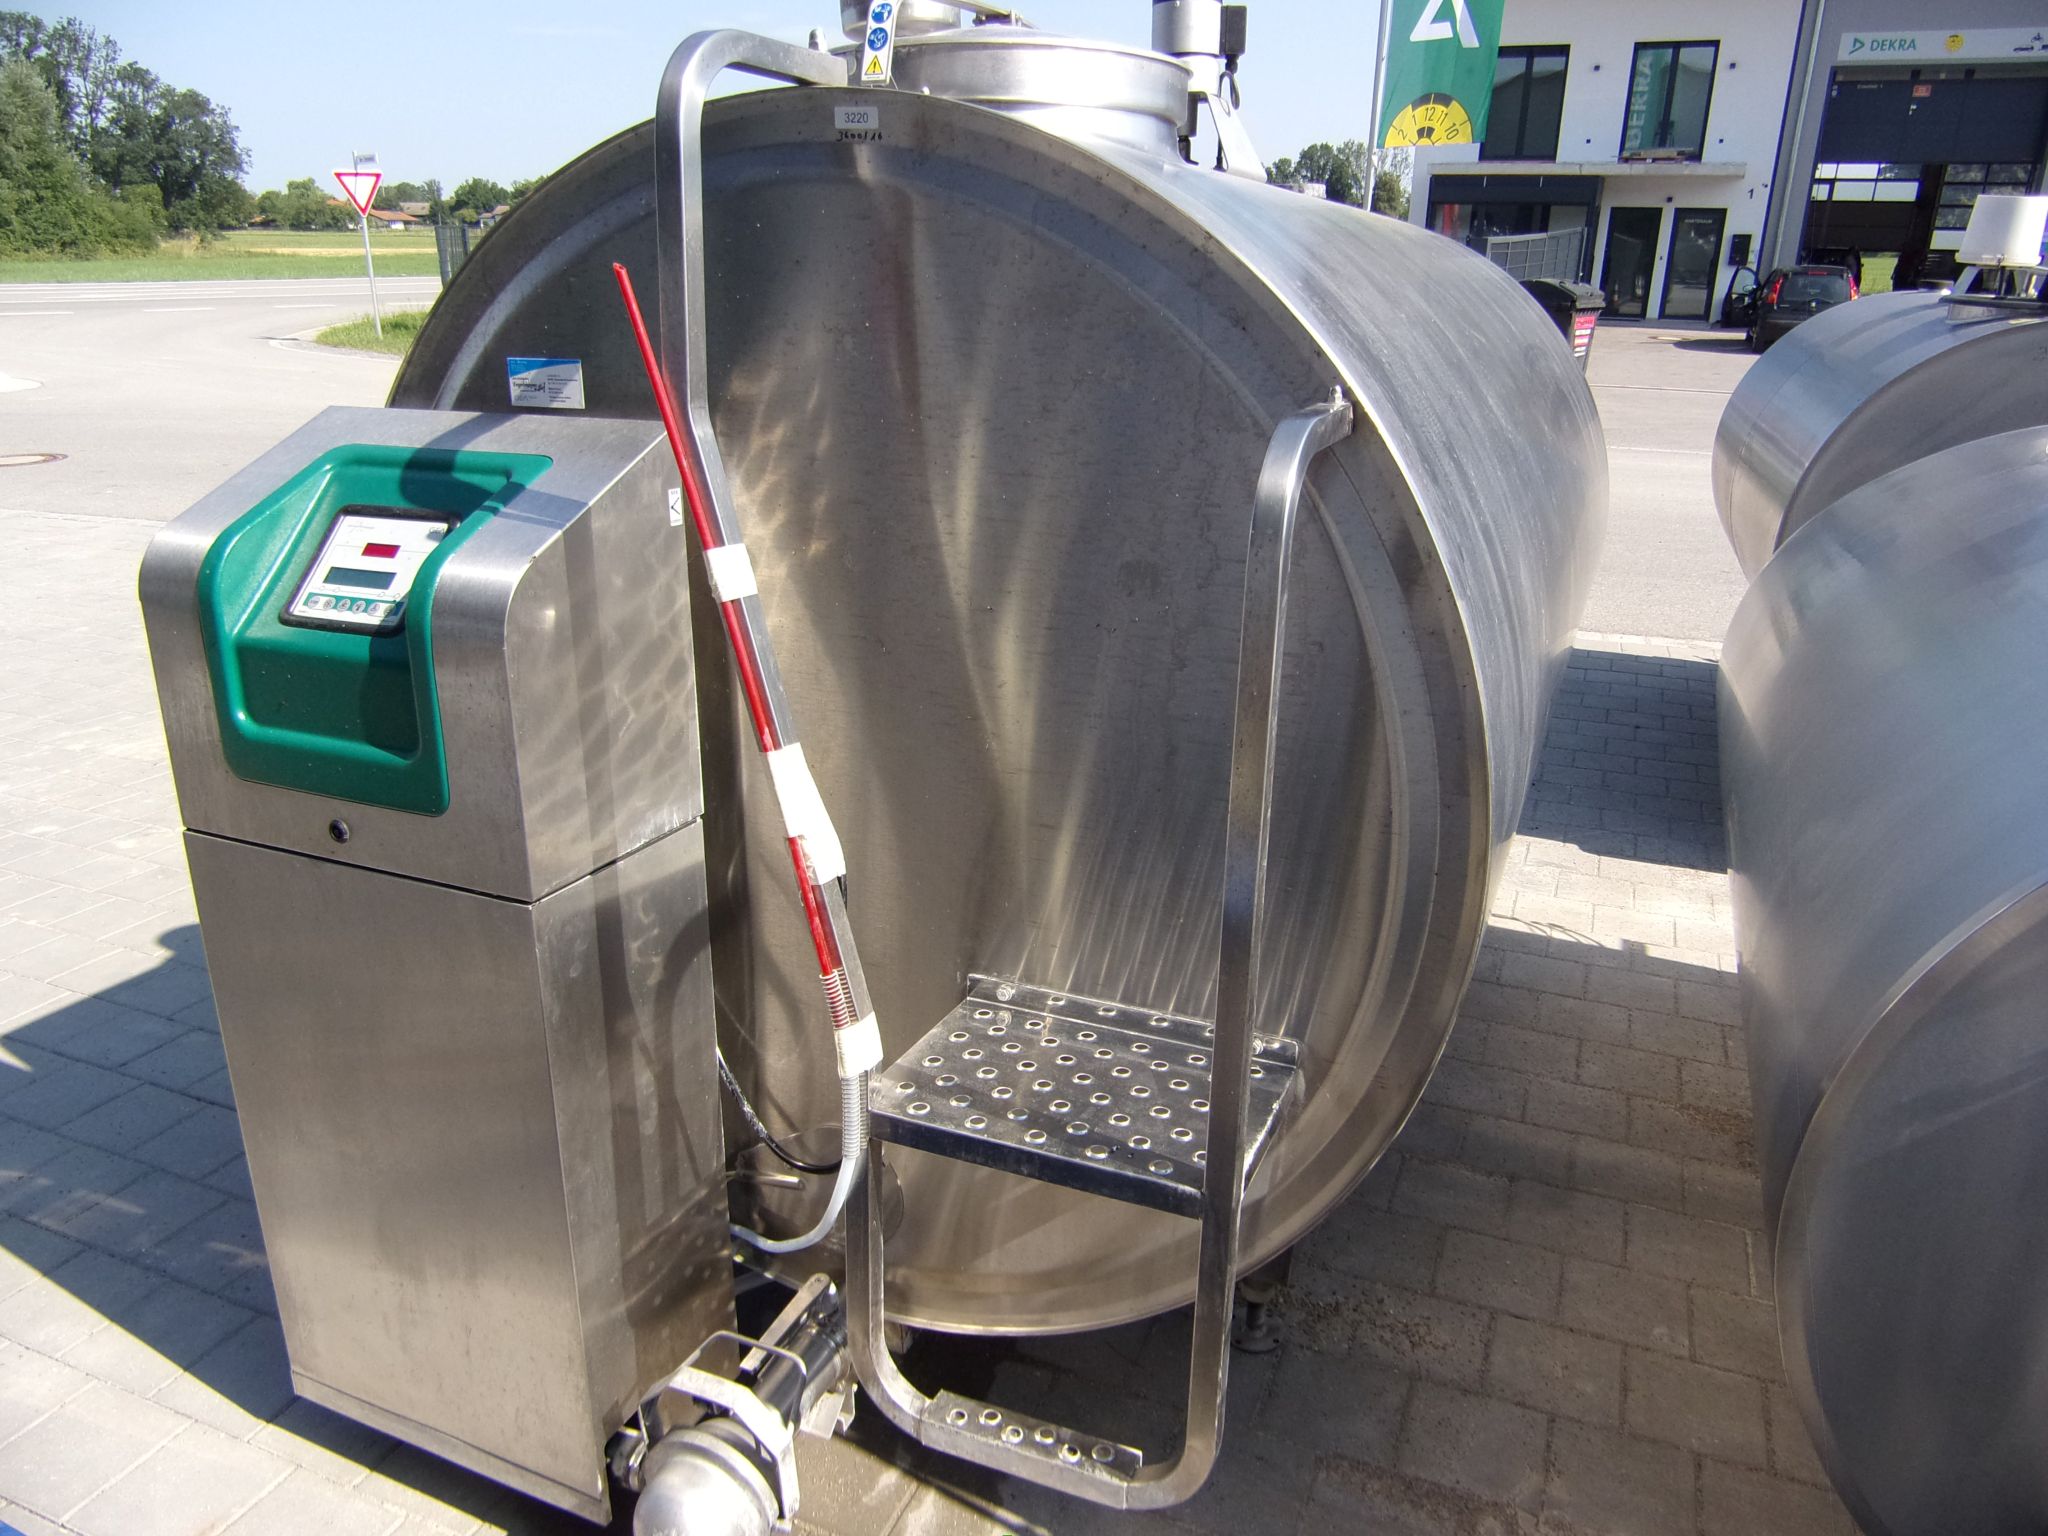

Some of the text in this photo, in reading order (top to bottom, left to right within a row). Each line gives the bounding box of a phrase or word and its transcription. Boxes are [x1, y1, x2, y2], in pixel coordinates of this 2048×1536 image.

[1870, 38, 1917, 51] DEKRA
[844, 112, 869, 124] 3220
[1398, 107, 1459, 140] 2 1 12 11 10
[1747, 188, 1755, 200] 1
